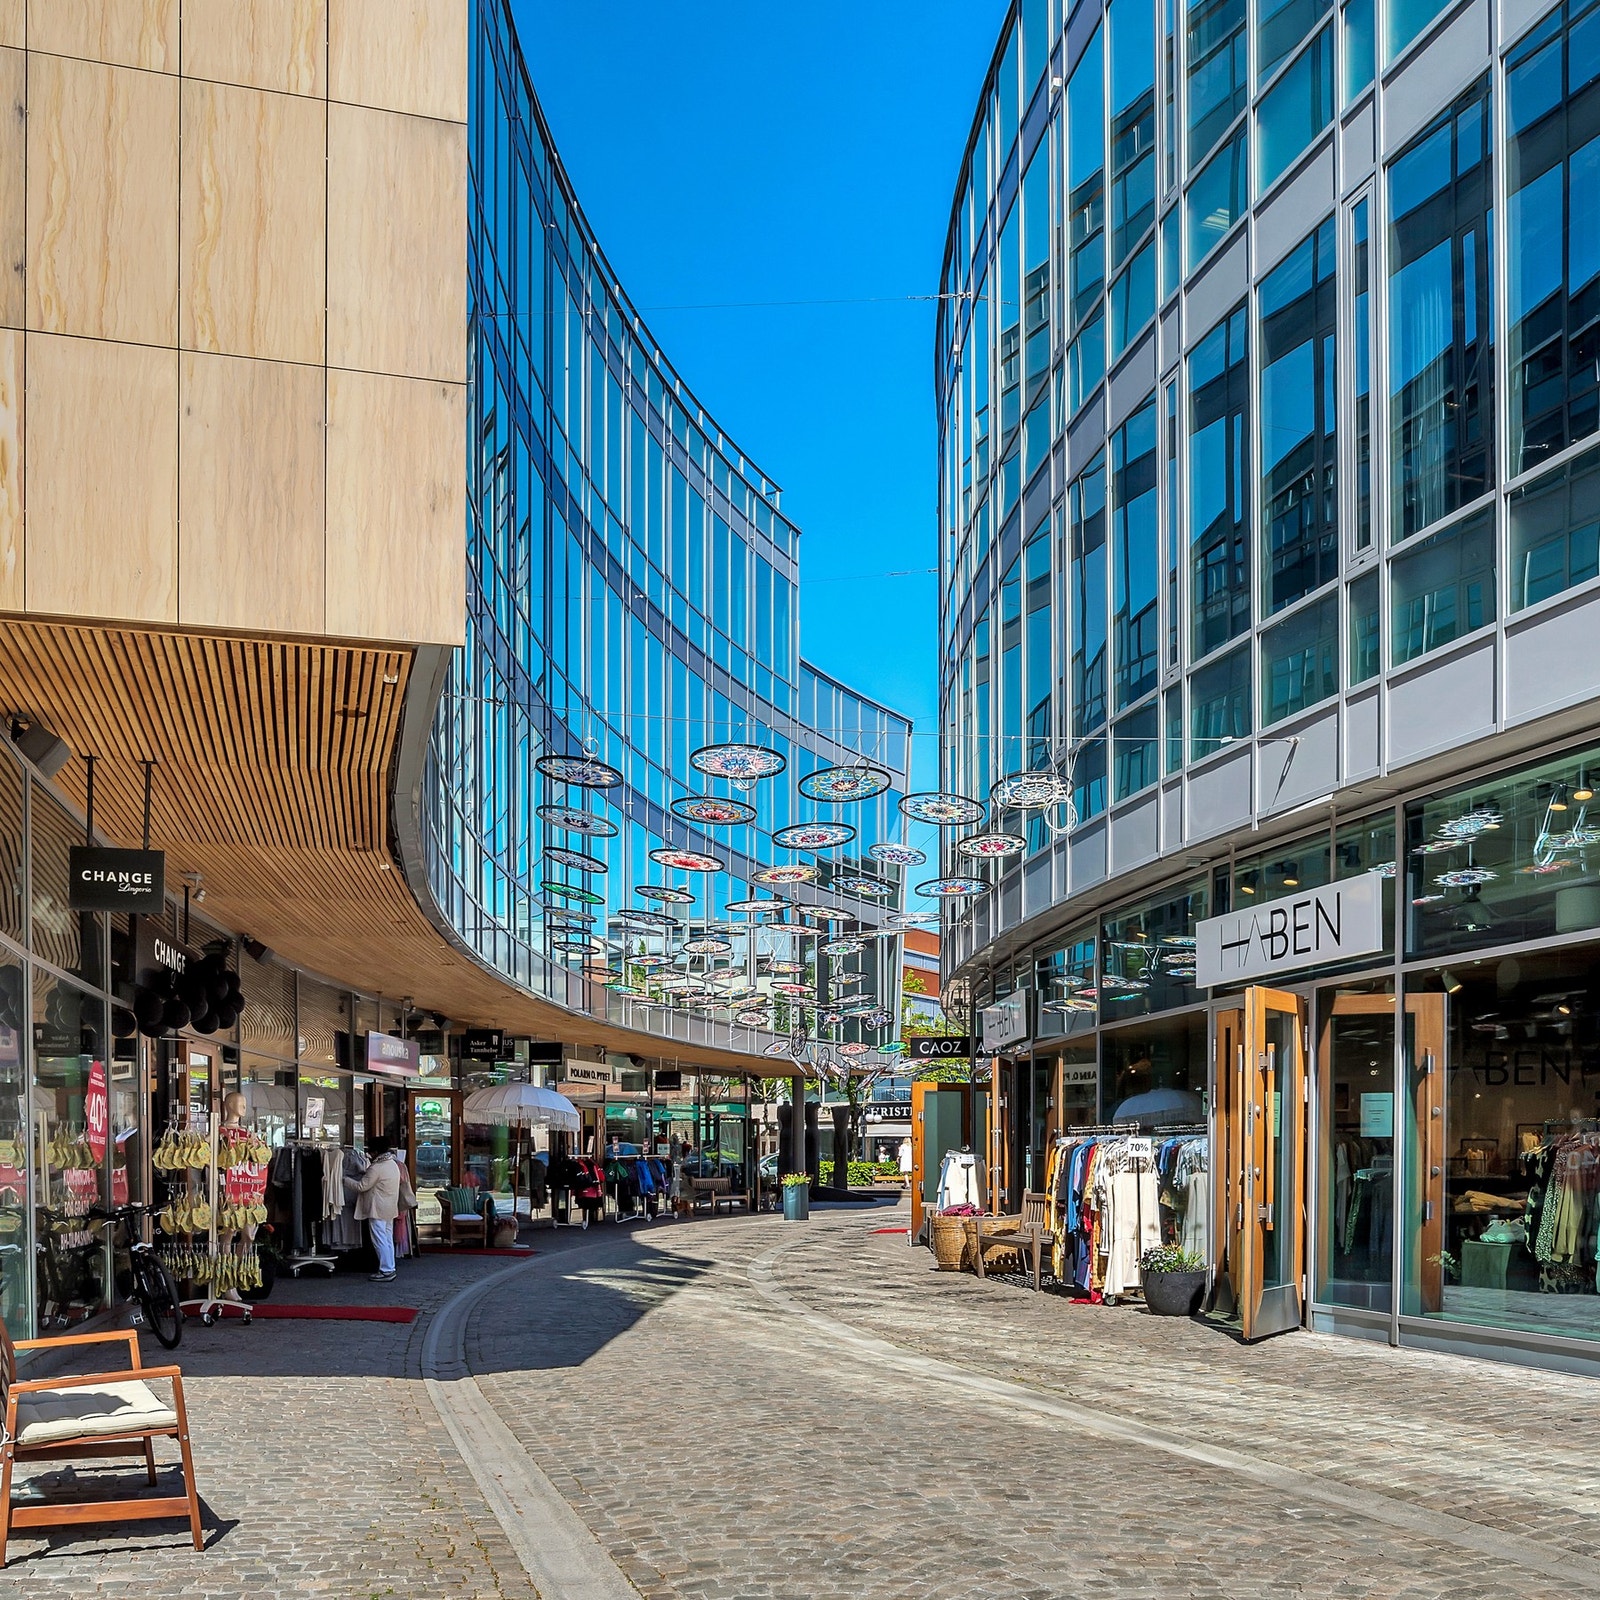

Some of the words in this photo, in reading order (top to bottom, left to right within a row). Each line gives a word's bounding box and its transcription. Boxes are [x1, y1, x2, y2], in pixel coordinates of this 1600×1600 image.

[81, 870, 152, 884] CHANGE
[117, 883, 152, 895] Lingerie
[1220, 891, 1341, 972] HABEN
[919, 1041, 961, 1054] CAOZ
[866, 1106, 912, 1117] HRIST
[1129, 1143, 1149, 1152] 70%
